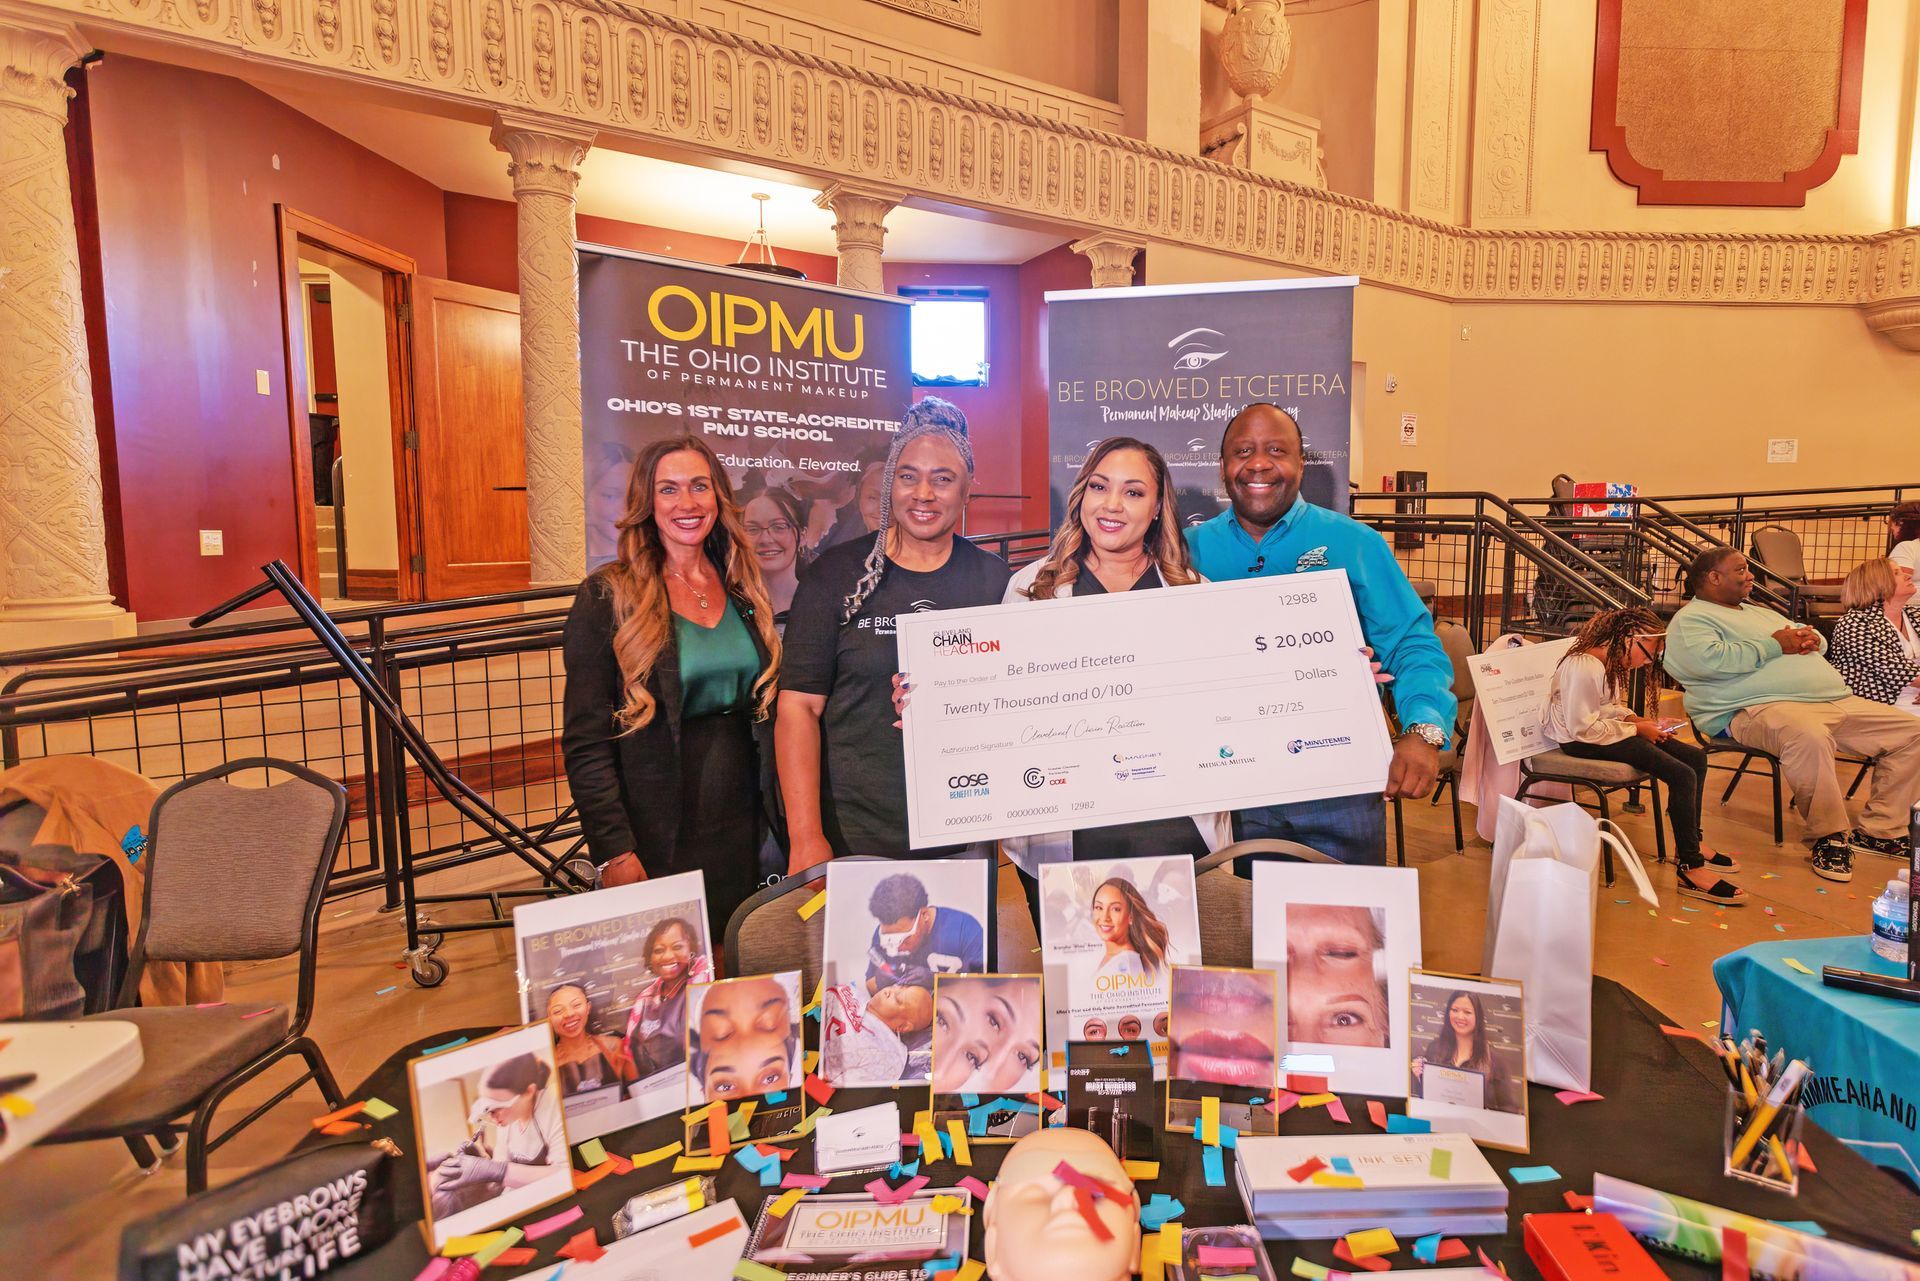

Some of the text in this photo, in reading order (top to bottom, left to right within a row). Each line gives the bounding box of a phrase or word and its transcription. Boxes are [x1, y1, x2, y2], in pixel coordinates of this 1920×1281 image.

[647, 285, 864, 361] OIPMU
[620, 339, 887, 389] THE OHIO INSTITUTE
[646, 369, 870, 399] OF PERMANENT MAKEUP
[1058, 373, 1346, 402] BE BROWED ETCETERA
[607, 397, 682, 416] OHIO'S
[687, 405, 723, 420] 1ST
[1099, 404, 1157, 423] Permanent
[1159, 404, 1201, 422] Makeup
[703, 422, 833, 443] PMU SCHOOL
[716, 453, 862, 473] Education. Elevated.
[1053, 455, 1088, 463] BE BROW
[1308, 450, 1348, 459] ETCETERA
[1279, 592, 1318, 606] 12988
[858, 616, 896, 629] BE BRO
[933, 633, 972, 647] CHAIN
[1255, 630, 1335, 653] $ 20,000
[1007, 664, 1023, 676] Be
[1027, 658, 1077, 674] Browed
[1081, 653, 1135, 668] Etcetera
[943, 667, 1338, 717] Twenty Thousand and 0/100 Dollars
[1258, 702, 1304, 716] 8/27/25
[941, 744, 979, 755] Authorized
[981, 741, 1014, 752] Signature
[1304, 736, 1351, 747] MINUTEMEN
[950, 787, 990, 799] BENEFIT PLAN
[945, 813, 992, 826] 000000526
[1071, 801, 1095, 812] 12982
[1096, 971, 1155, 991] OIPMU
[1358, 1156, 1384, 1164] INK
[177, 1169, 368, 1268] MY EYEBROWS
[815, 1207, 925, 1230] OIPMU
[178, 1190, 364, 1281] HAVE MORE
[281, 1226, 362, 1281] LIFE
[785, 1268, 930, 1281] EGINNER'S GUIDE TO
